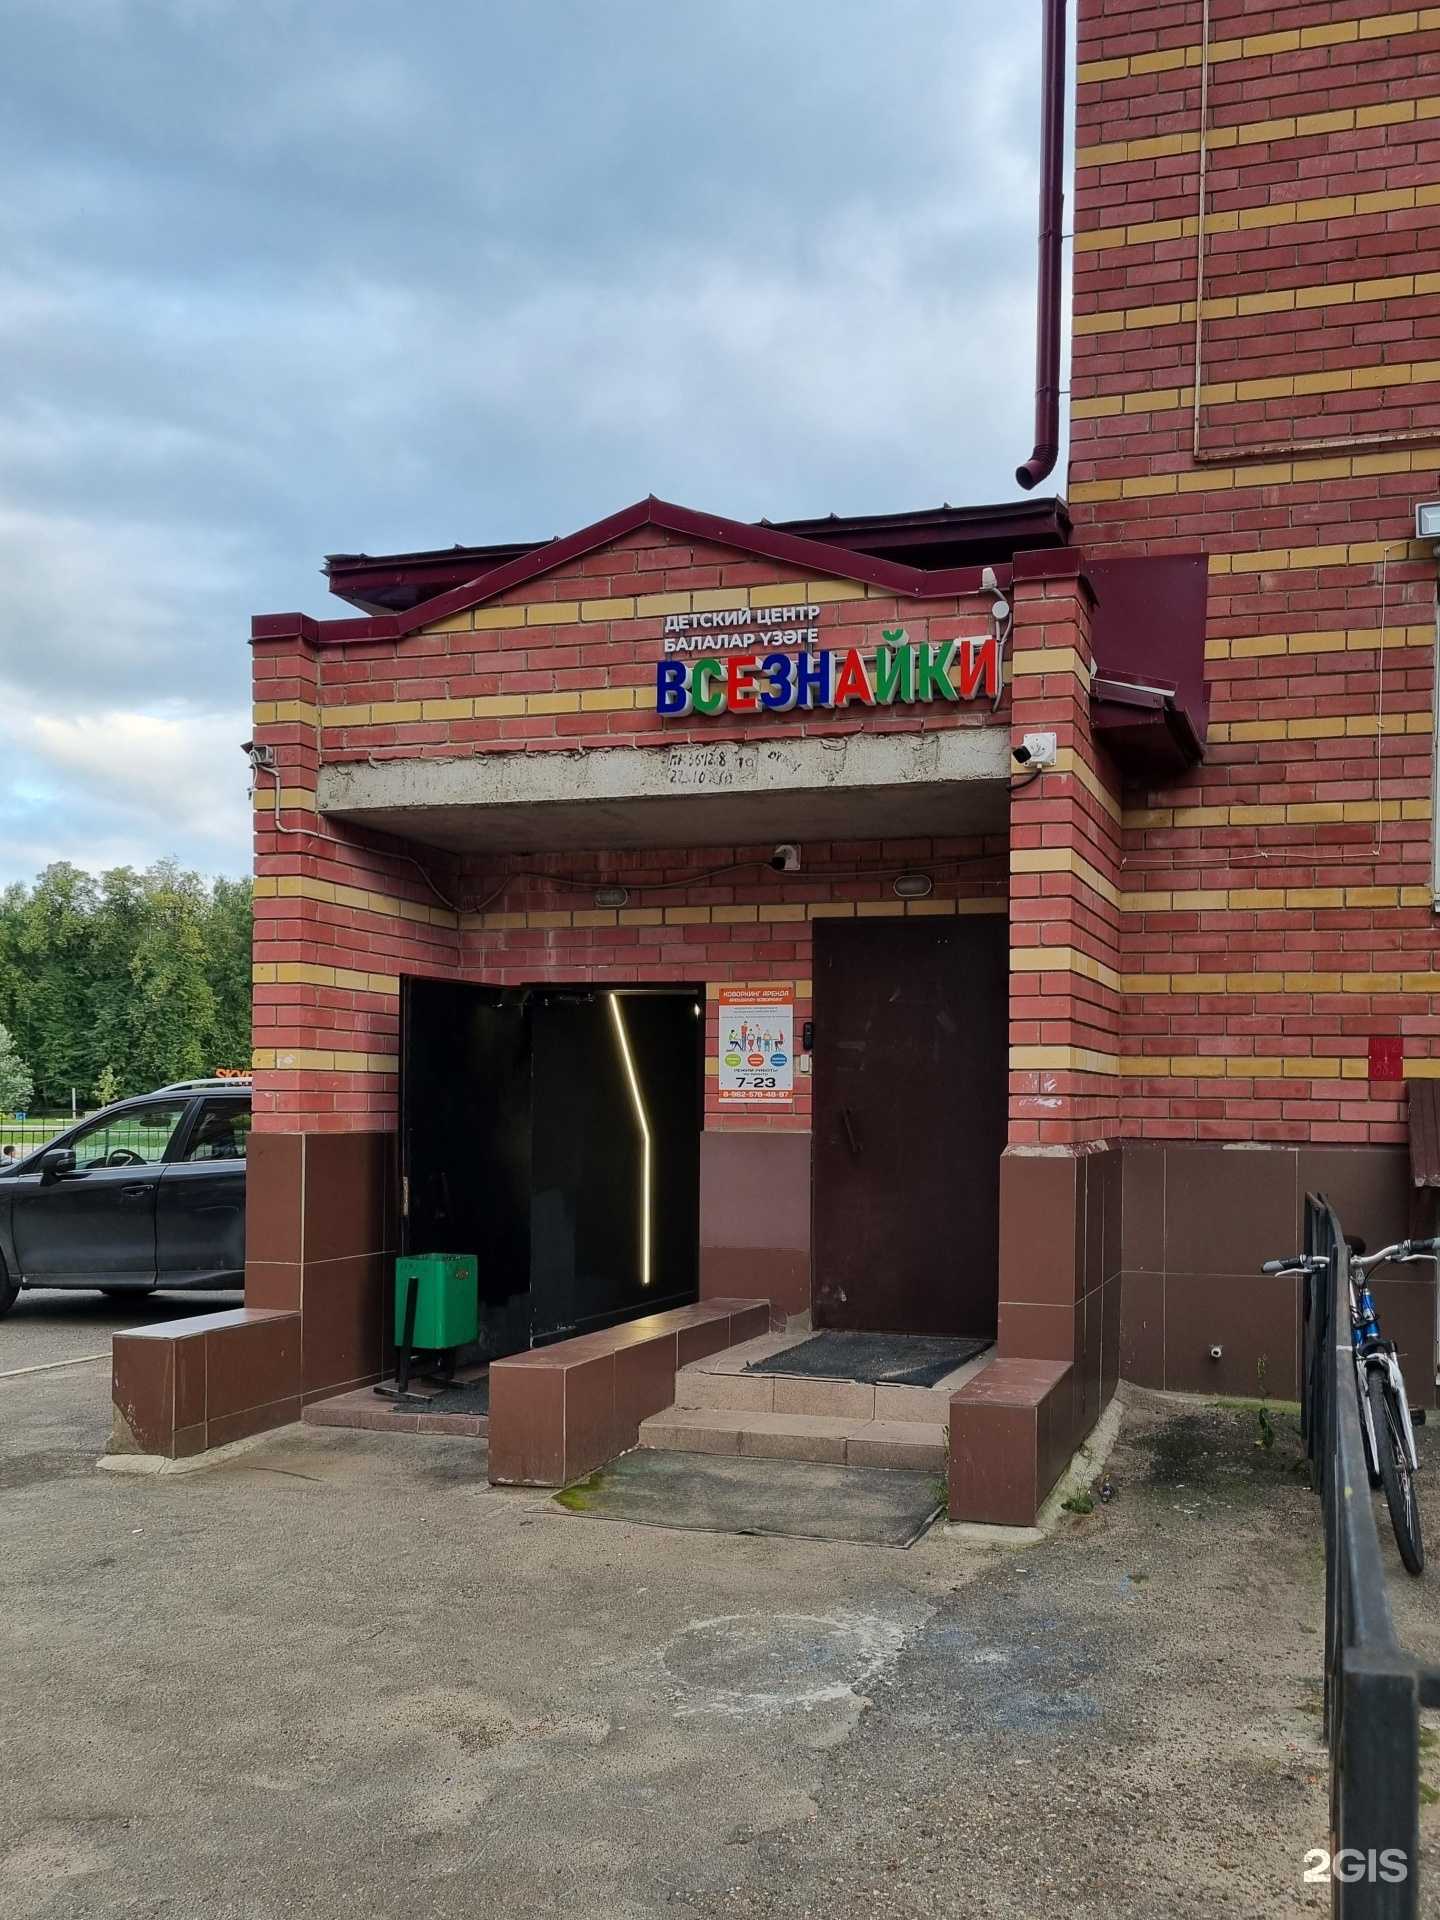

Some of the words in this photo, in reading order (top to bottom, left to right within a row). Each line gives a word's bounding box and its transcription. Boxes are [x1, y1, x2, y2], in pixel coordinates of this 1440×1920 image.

[664, 607, 751, 633] ДЕТСКИЙ
[756, 605, 821, 626] ЦЕНТР
[664, 633, 755, 653] БАЛАЛАР
[655, 628, 999, 718] ВСЕЗНАЙКИ
[735, 1077, 777, 1088] 7-23
